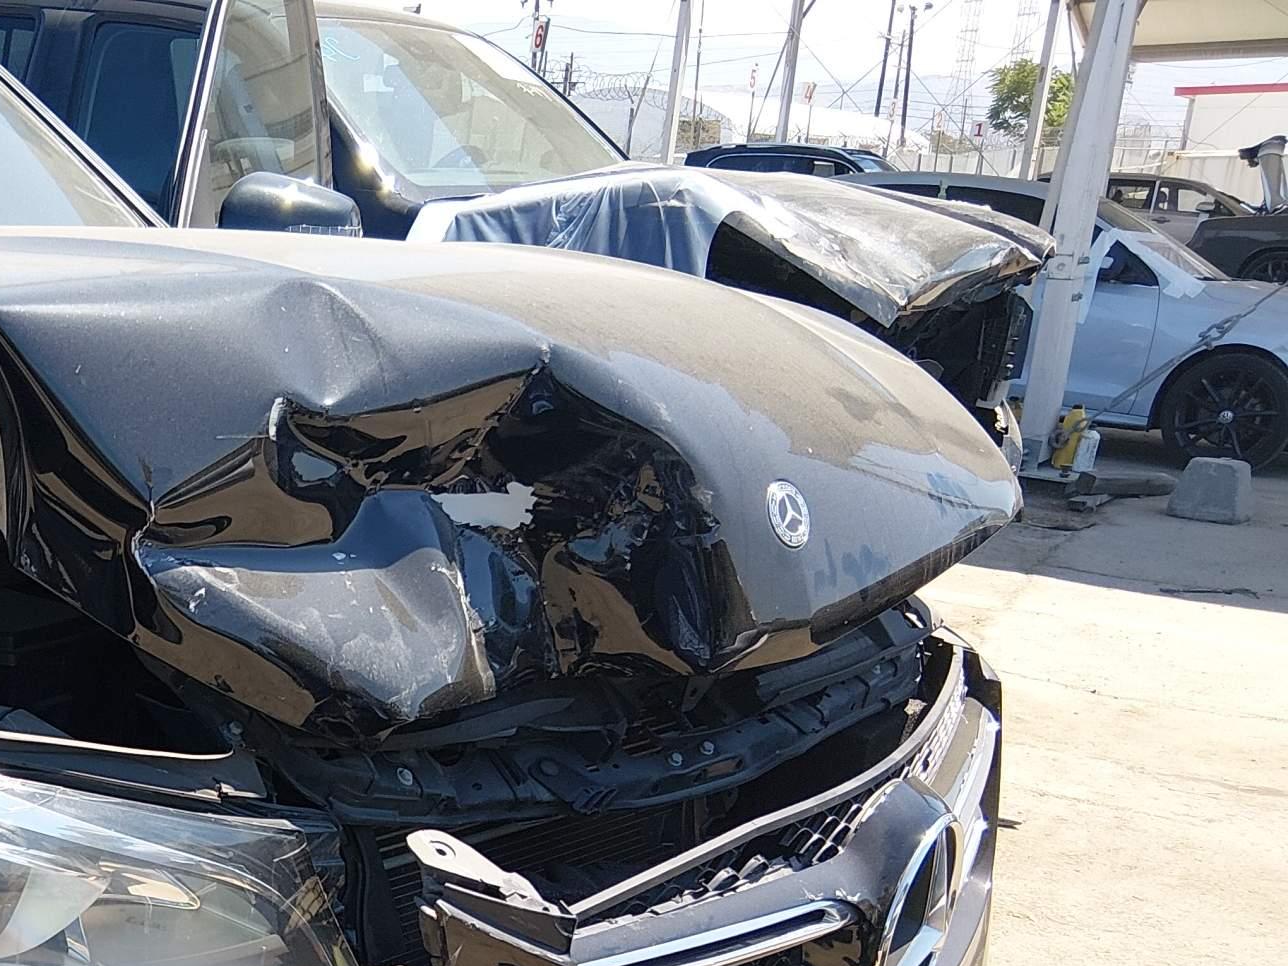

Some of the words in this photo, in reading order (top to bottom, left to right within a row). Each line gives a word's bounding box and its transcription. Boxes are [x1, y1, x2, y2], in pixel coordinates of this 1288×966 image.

[534, 24, 544, 49] 6
[749, 68, 757, 89] 5
[804, 84, 814, 104] 4
[973, 122, 984, 137] 1
